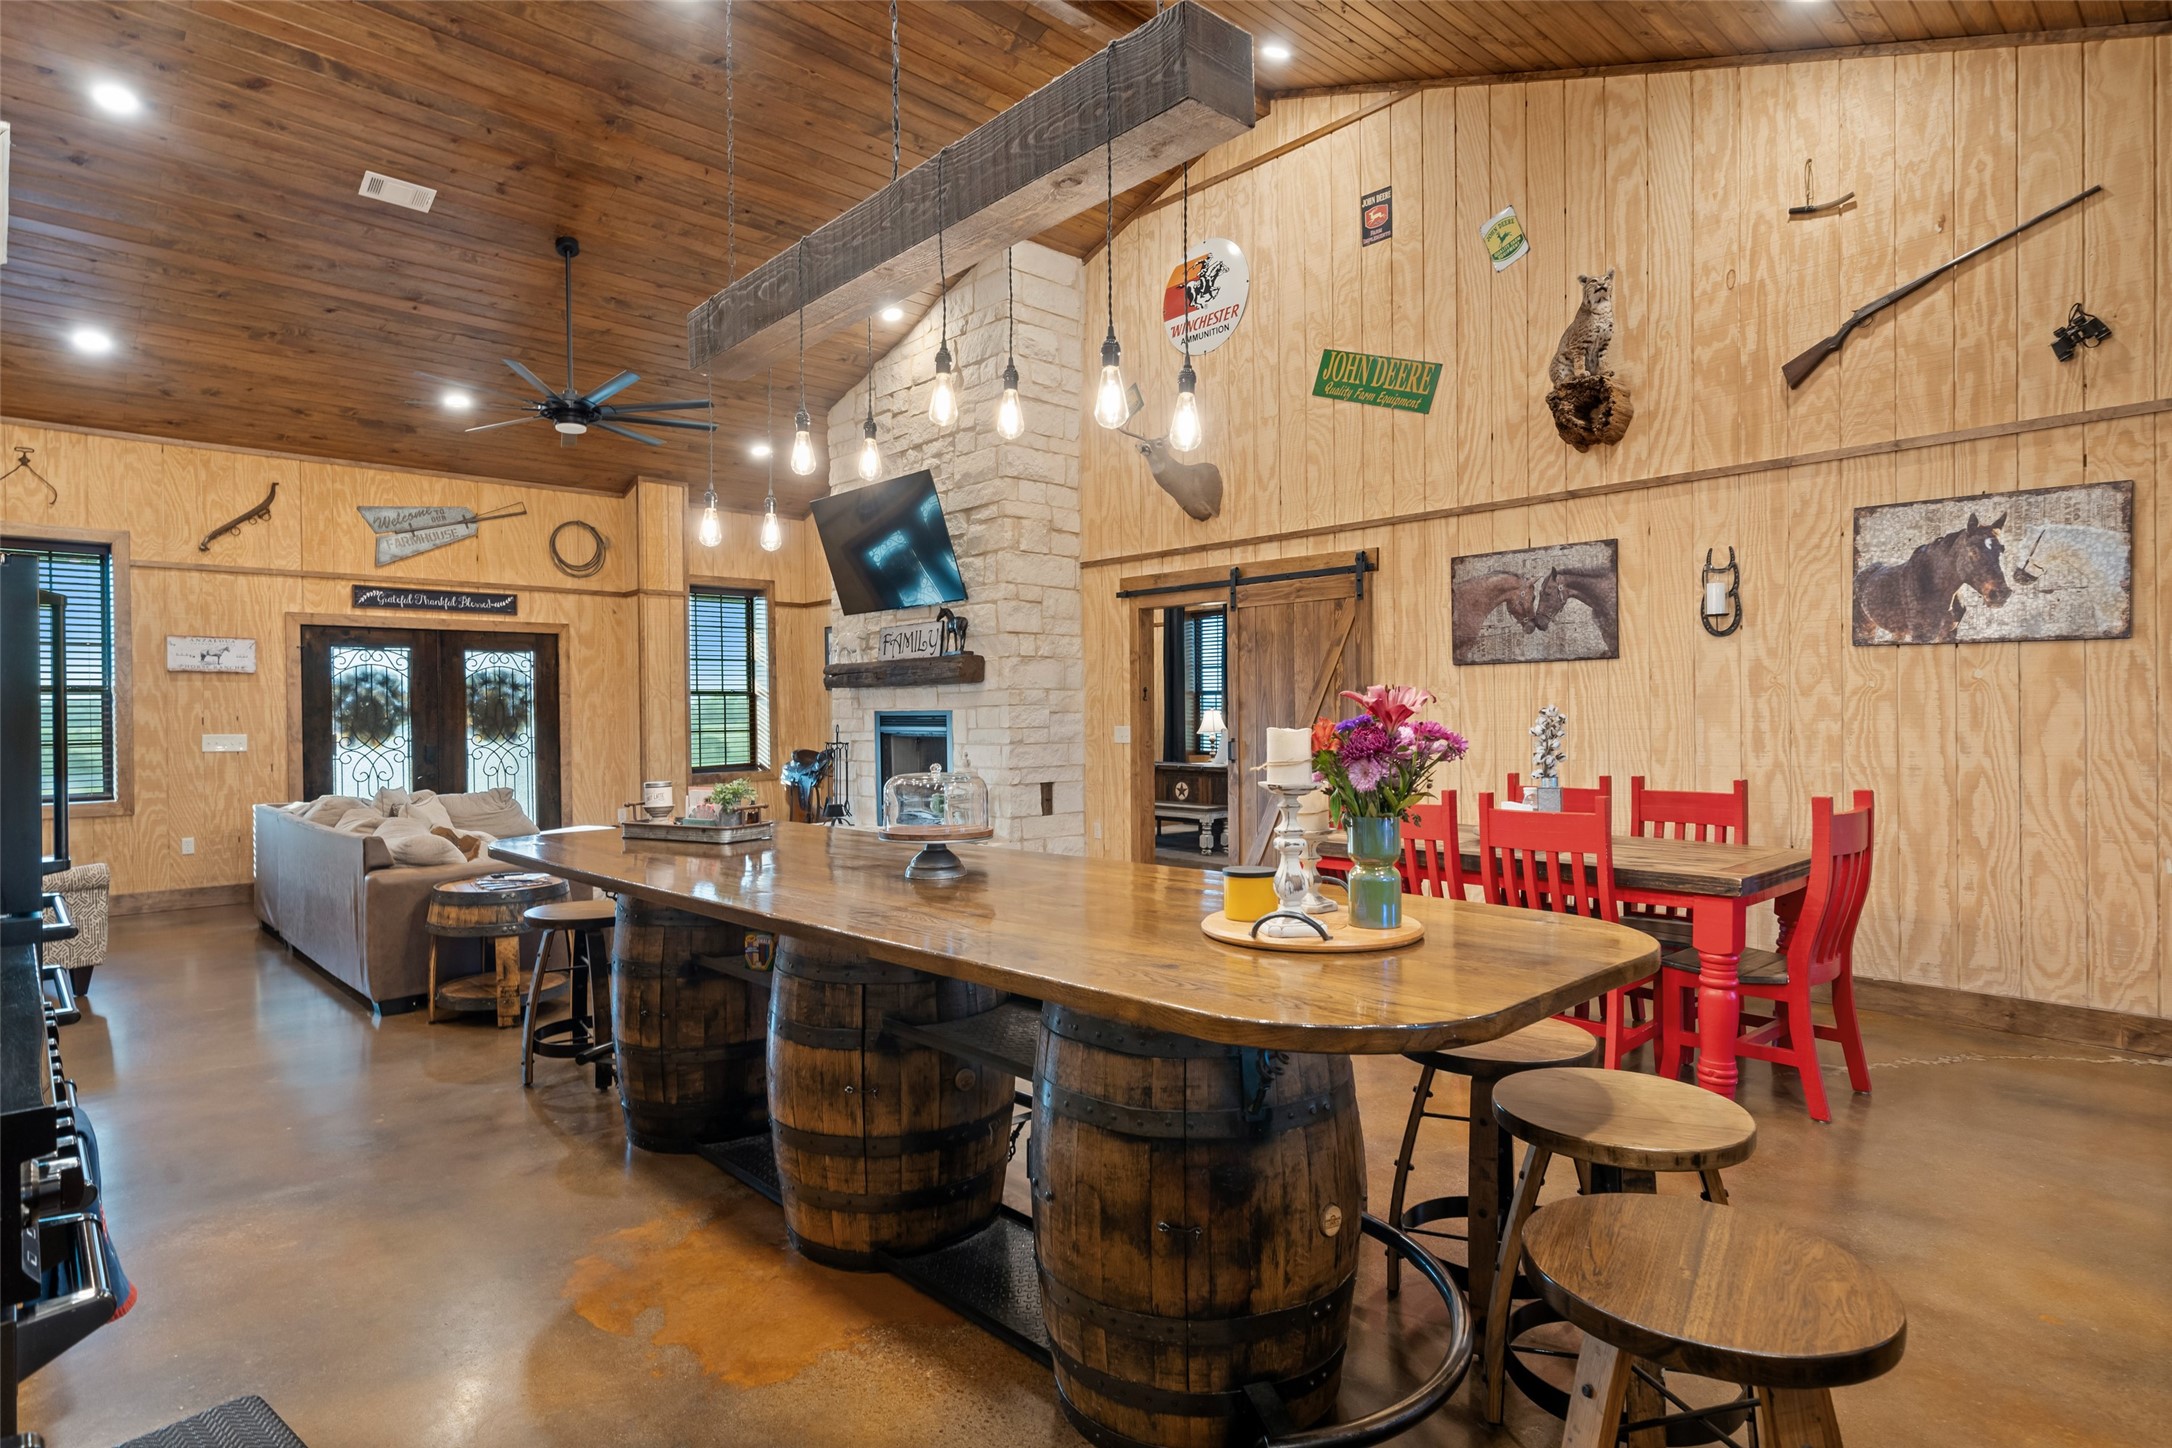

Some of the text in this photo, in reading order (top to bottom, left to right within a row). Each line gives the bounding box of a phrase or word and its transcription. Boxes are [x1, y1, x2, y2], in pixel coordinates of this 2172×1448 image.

[1171, 304, 1239, 338] WINCHESTER
[1181, 324, 1230, 345] AMMUNITION
[1323, 351, 1435, 395] JOHN DEERE
[1325, 381, 1422, 409] Quality Farm Equipment
[373, 507, 432, 529] Welcome
[431, 515, 447, 523] OUR
[385, 528, 459, 550] FARMHOUSE
[377, 593, 492, 610] Grateful Thankful Blessed
[883, 628, 940, 659] FAMILY
